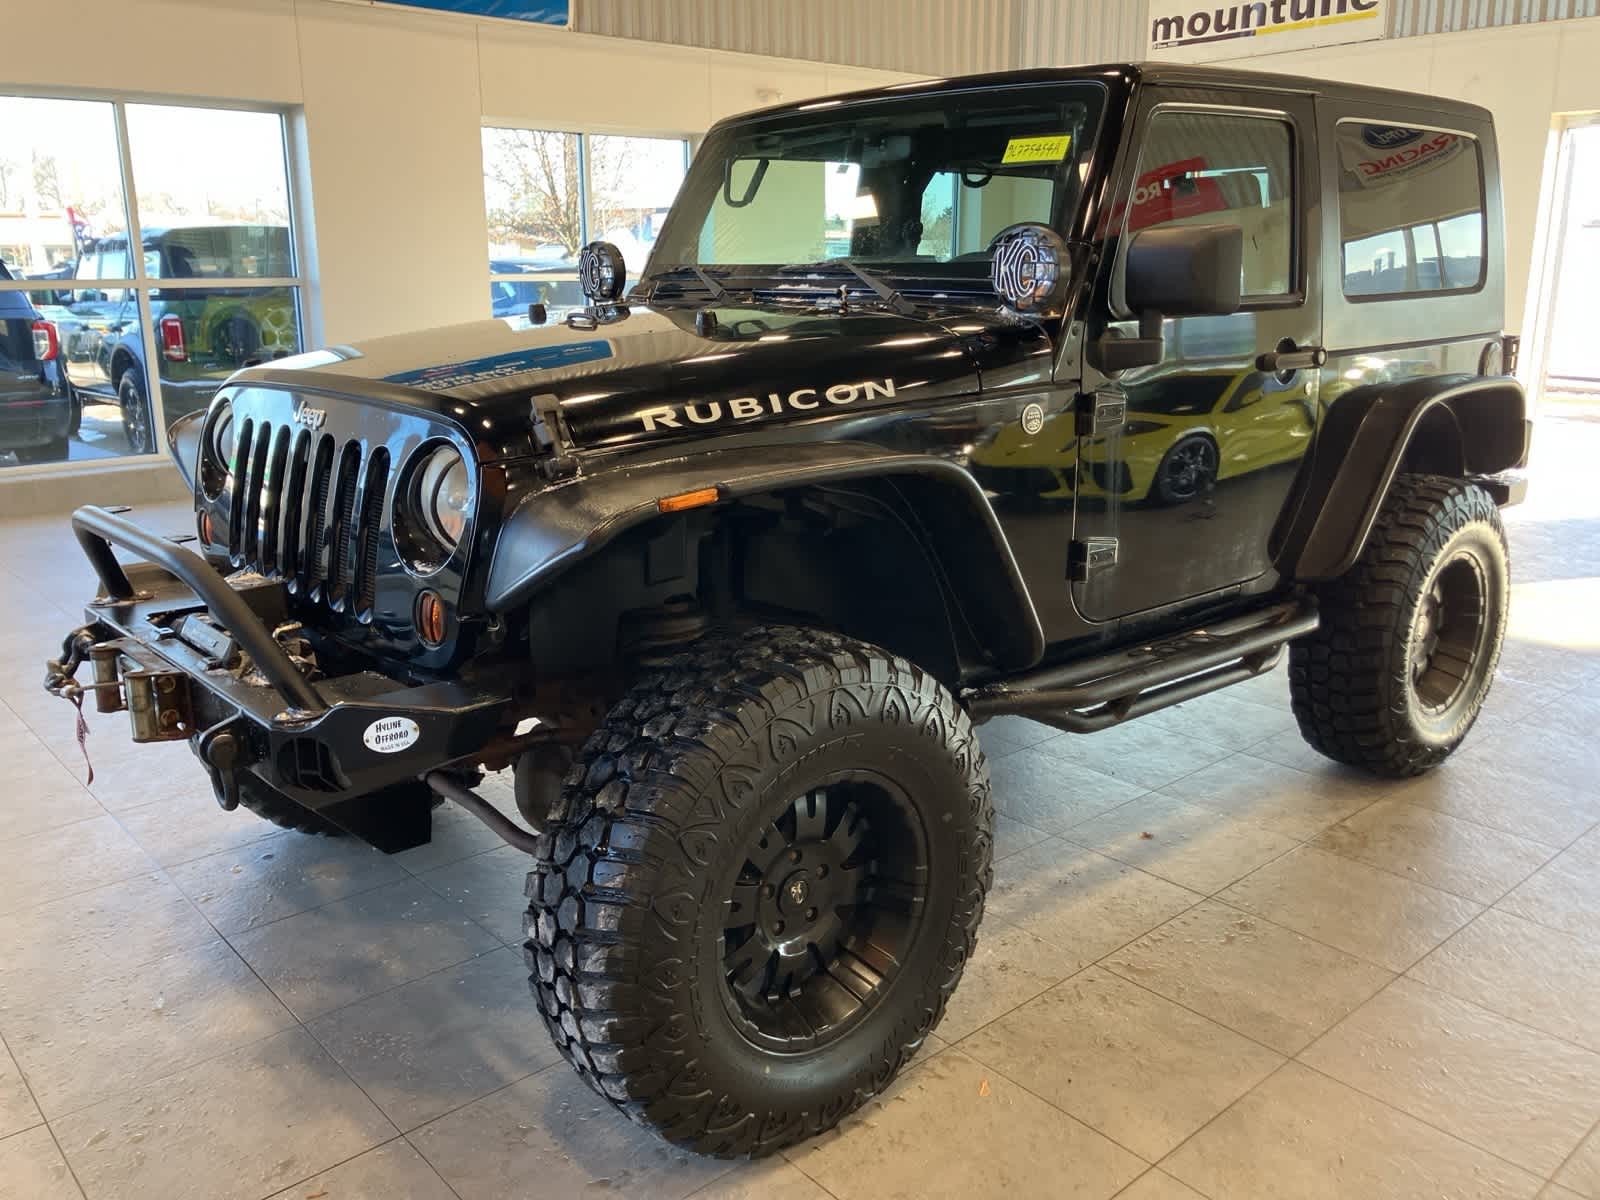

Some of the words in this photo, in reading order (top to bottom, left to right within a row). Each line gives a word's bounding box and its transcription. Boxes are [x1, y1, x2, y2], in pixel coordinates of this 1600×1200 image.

[579, 250, 600, 294] KC
[995, 239, 1038, 301] KC
[293, 400, 326, 430] Jeep
[639, 378, 897, 431] RUBICON
[375, 720, 402, 733] HYLINE
[375, 730, 409, 745] OFFROAD
